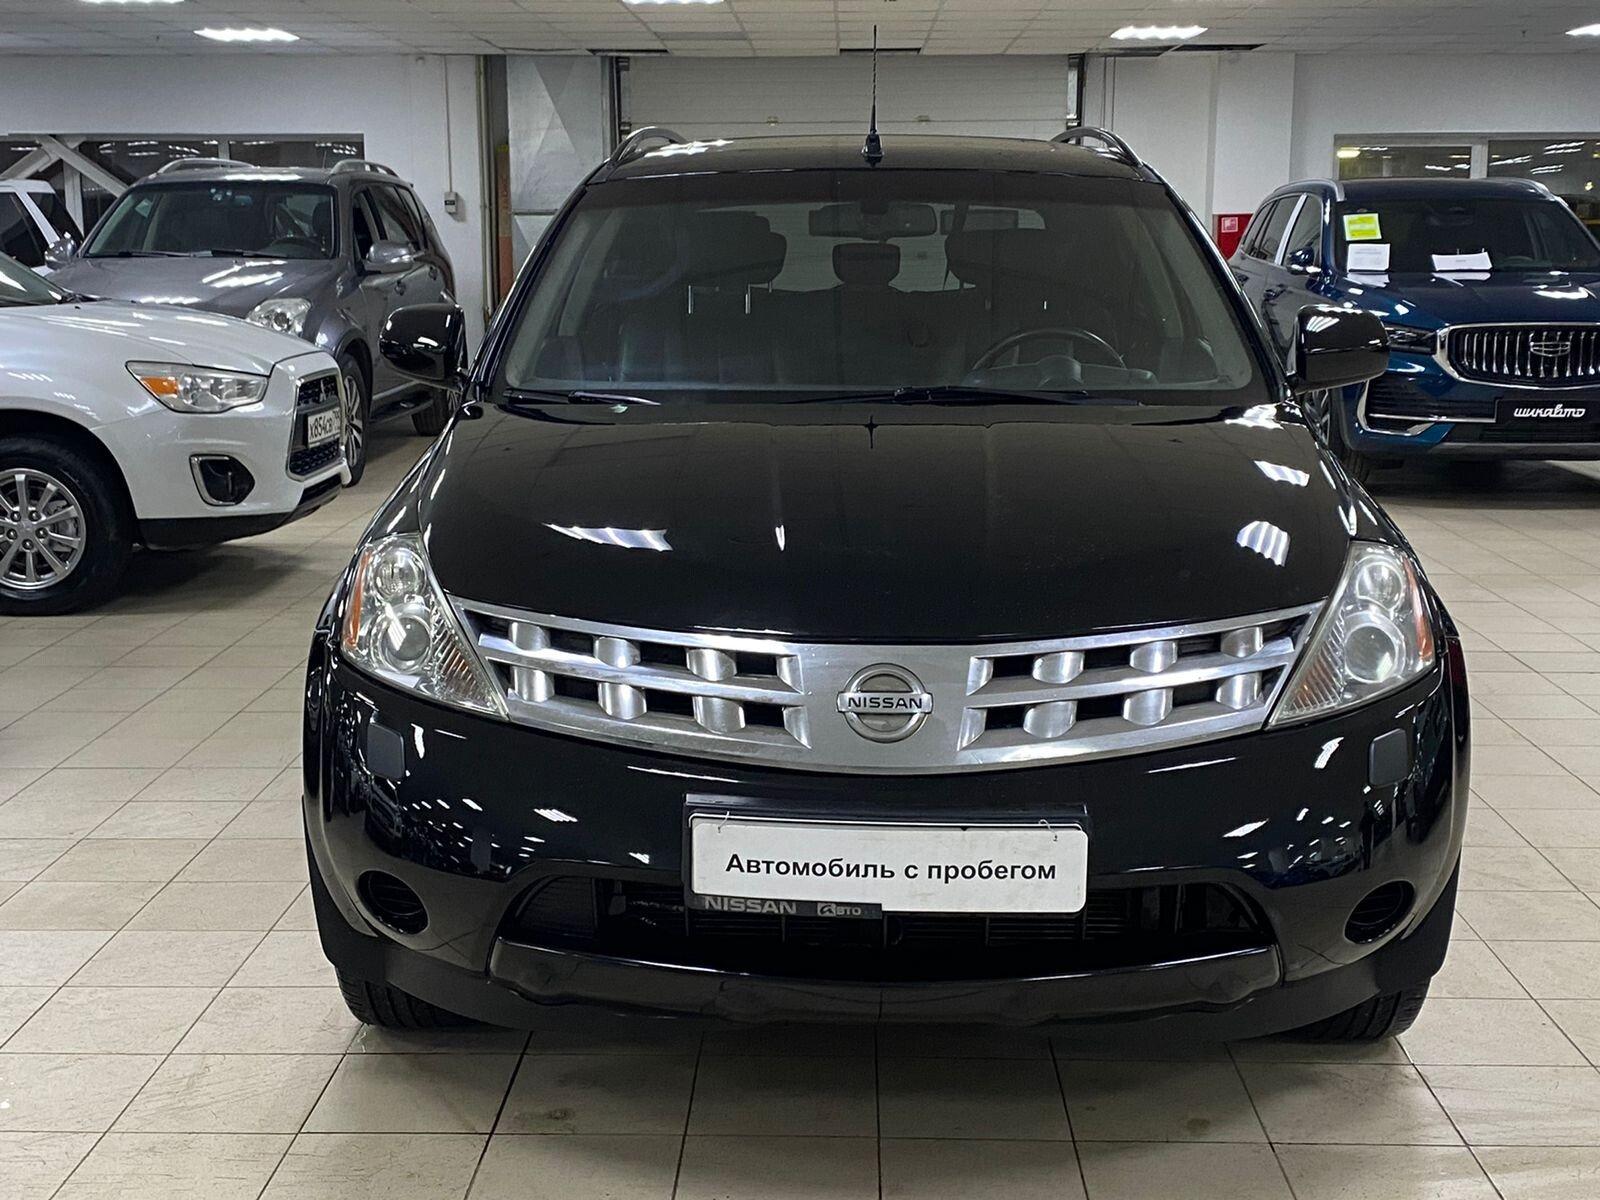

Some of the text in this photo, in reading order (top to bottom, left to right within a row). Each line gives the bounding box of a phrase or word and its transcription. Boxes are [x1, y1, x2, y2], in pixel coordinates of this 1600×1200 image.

[848, 697, 922, 709] NISSAN
[725, 854, 1056, 885] Автомобиль с пробегом
[704, 896, 798, 915] NISSAN
